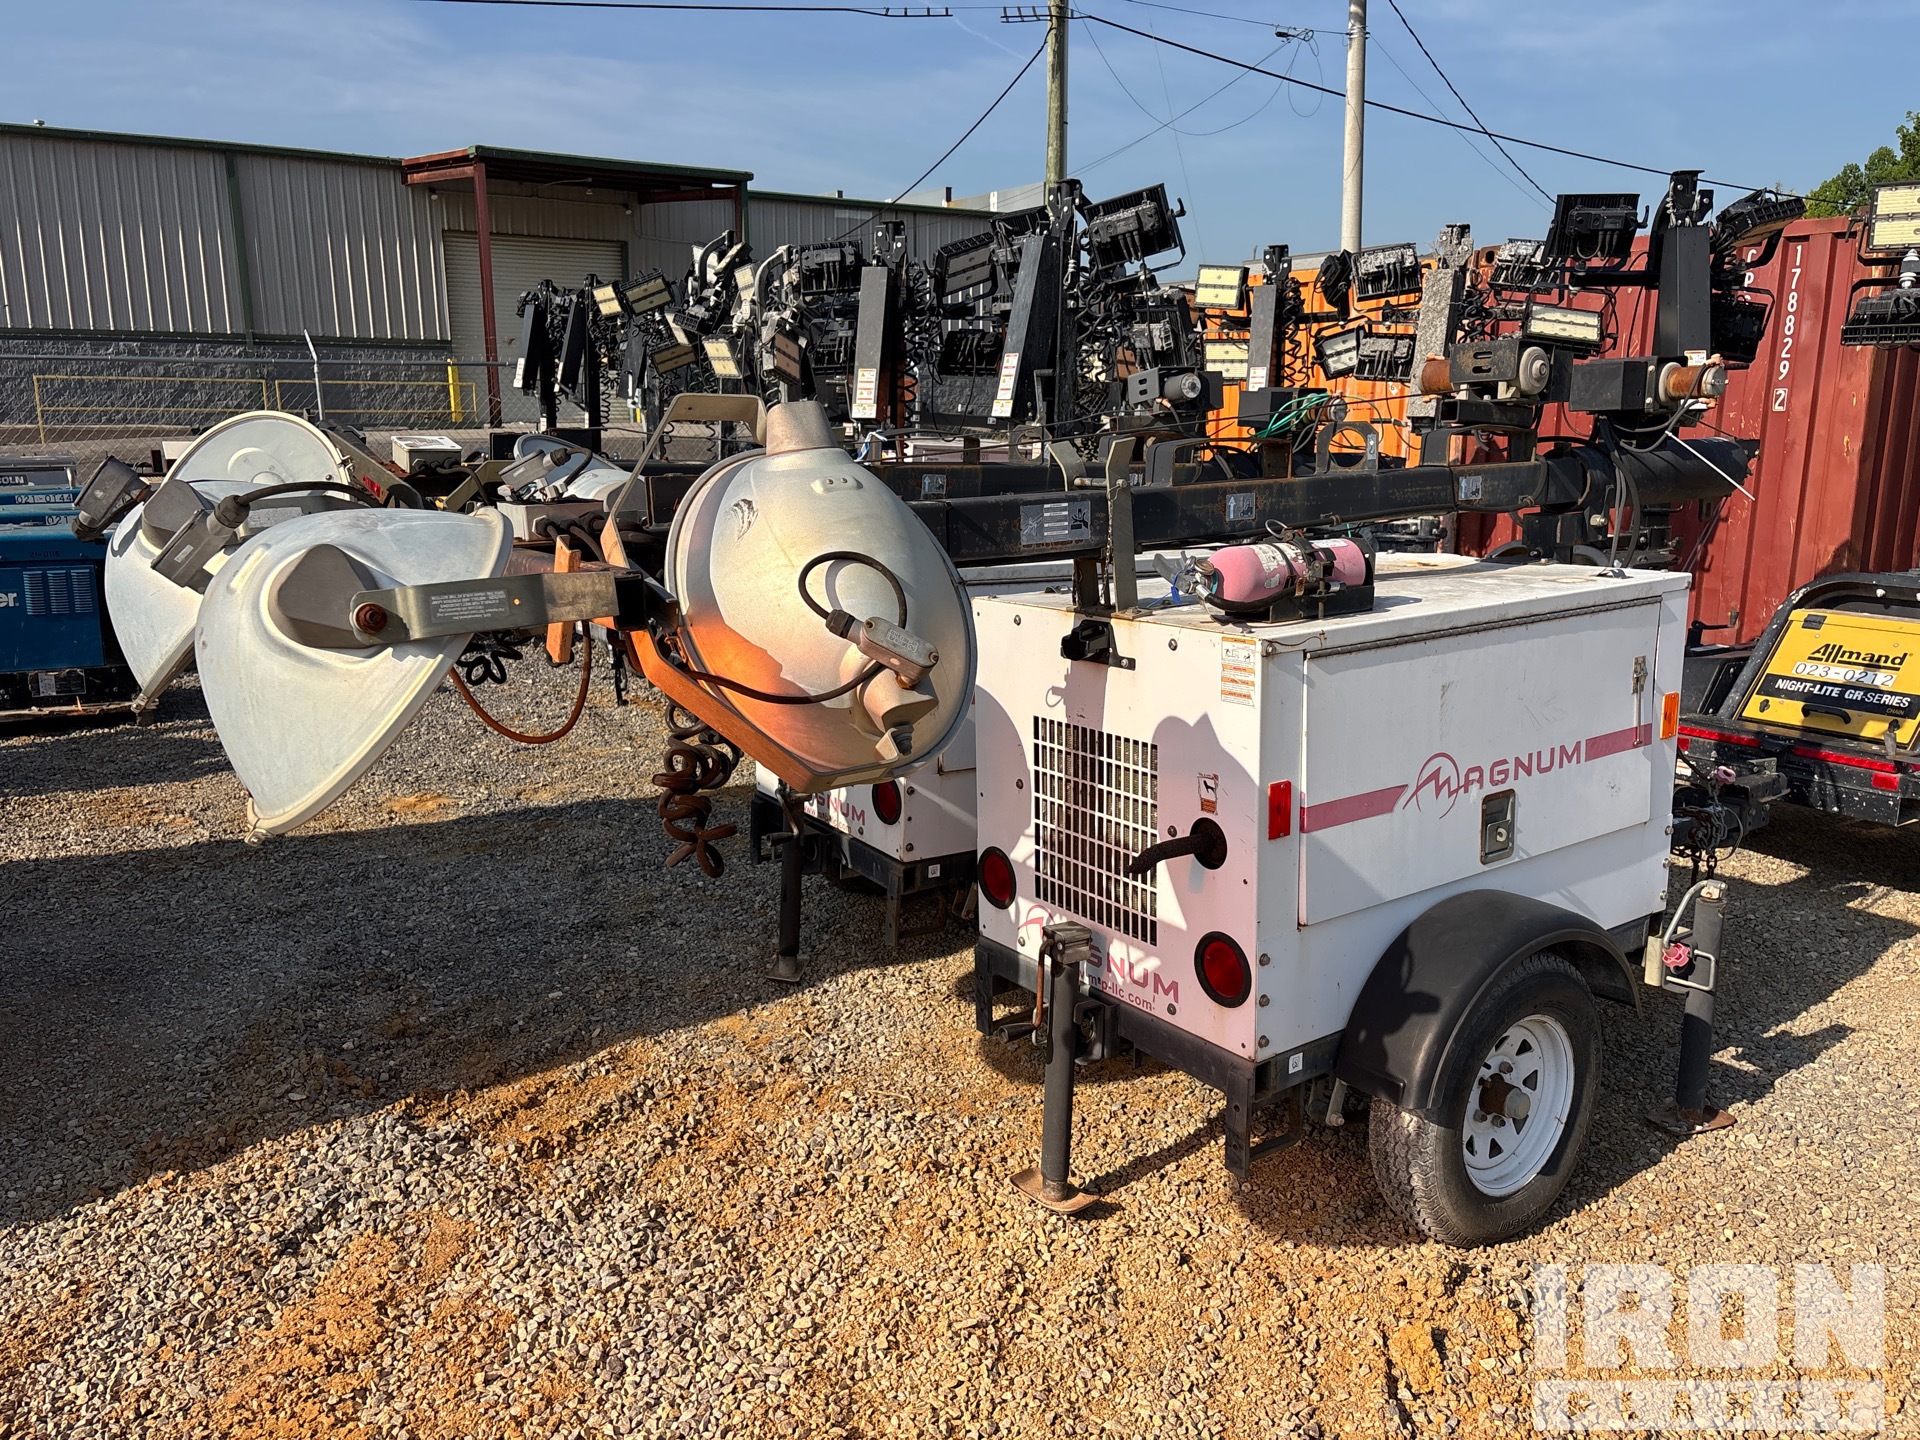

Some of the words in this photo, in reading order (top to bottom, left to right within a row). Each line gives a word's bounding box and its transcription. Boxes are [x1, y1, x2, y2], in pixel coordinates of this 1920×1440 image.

[1777, 244, 1803, 381] 178829
[1774, 389, 1786, 410] 2
[0, 476, 24, 485] OLN
[16, 494, 72, 504] 021-0144
[1809, 643, 1909, 668] Allmand
[1795, 663, 1894, 687] 023-0212
[1775, 678, 1842, 698] NIGHT-LITE
[1844, 688, 1911, 708] GR-SERIES
[1402, 740, 1582, 819] MAGNUM
